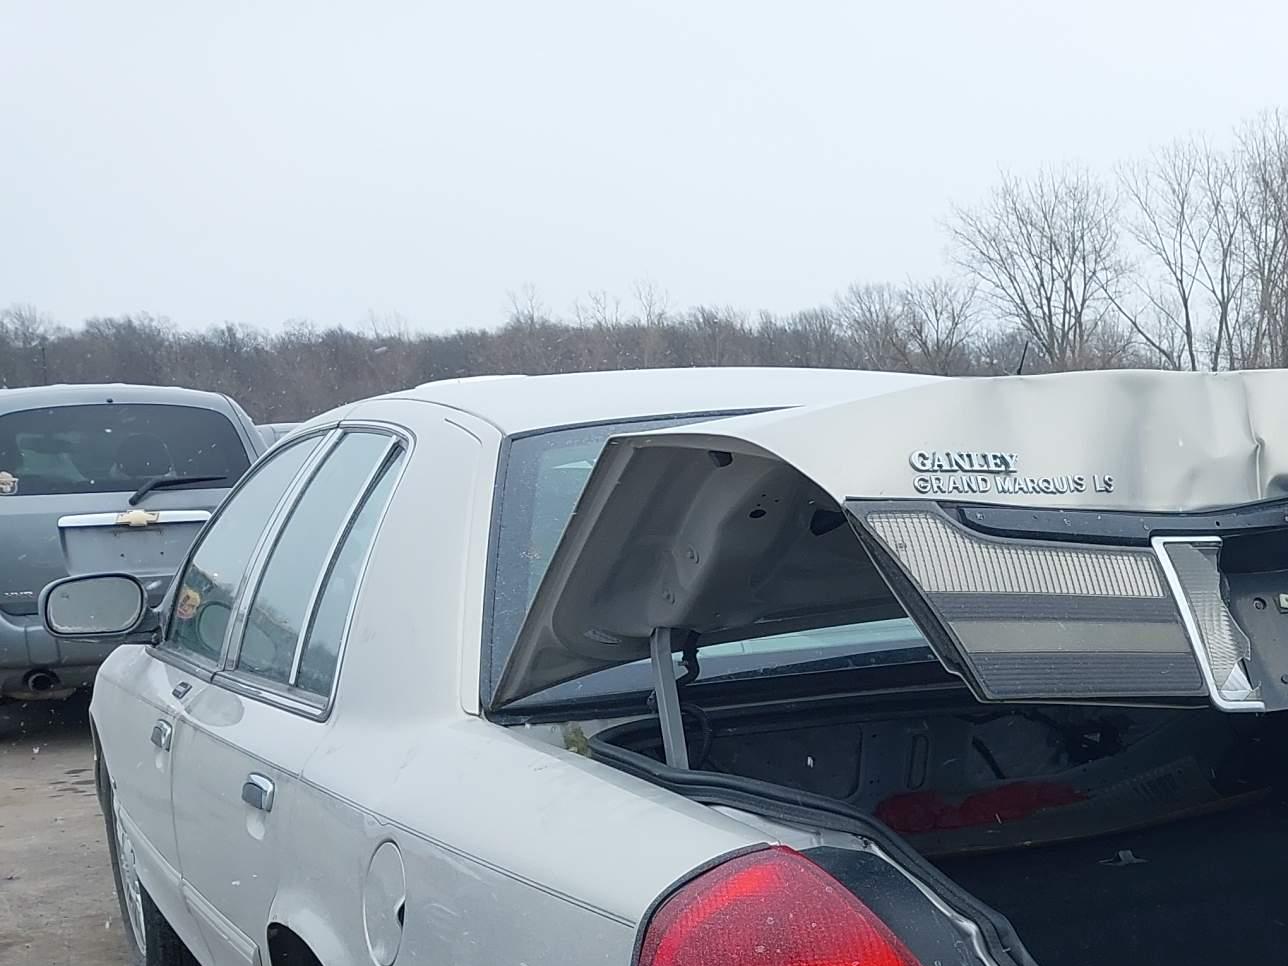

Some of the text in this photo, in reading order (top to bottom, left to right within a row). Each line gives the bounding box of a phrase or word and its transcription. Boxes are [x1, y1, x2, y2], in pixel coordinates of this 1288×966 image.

[909, 450, 1017, 473] GANLEY
[913, 474, 1115, 495] GRAND MARQUIS LS
